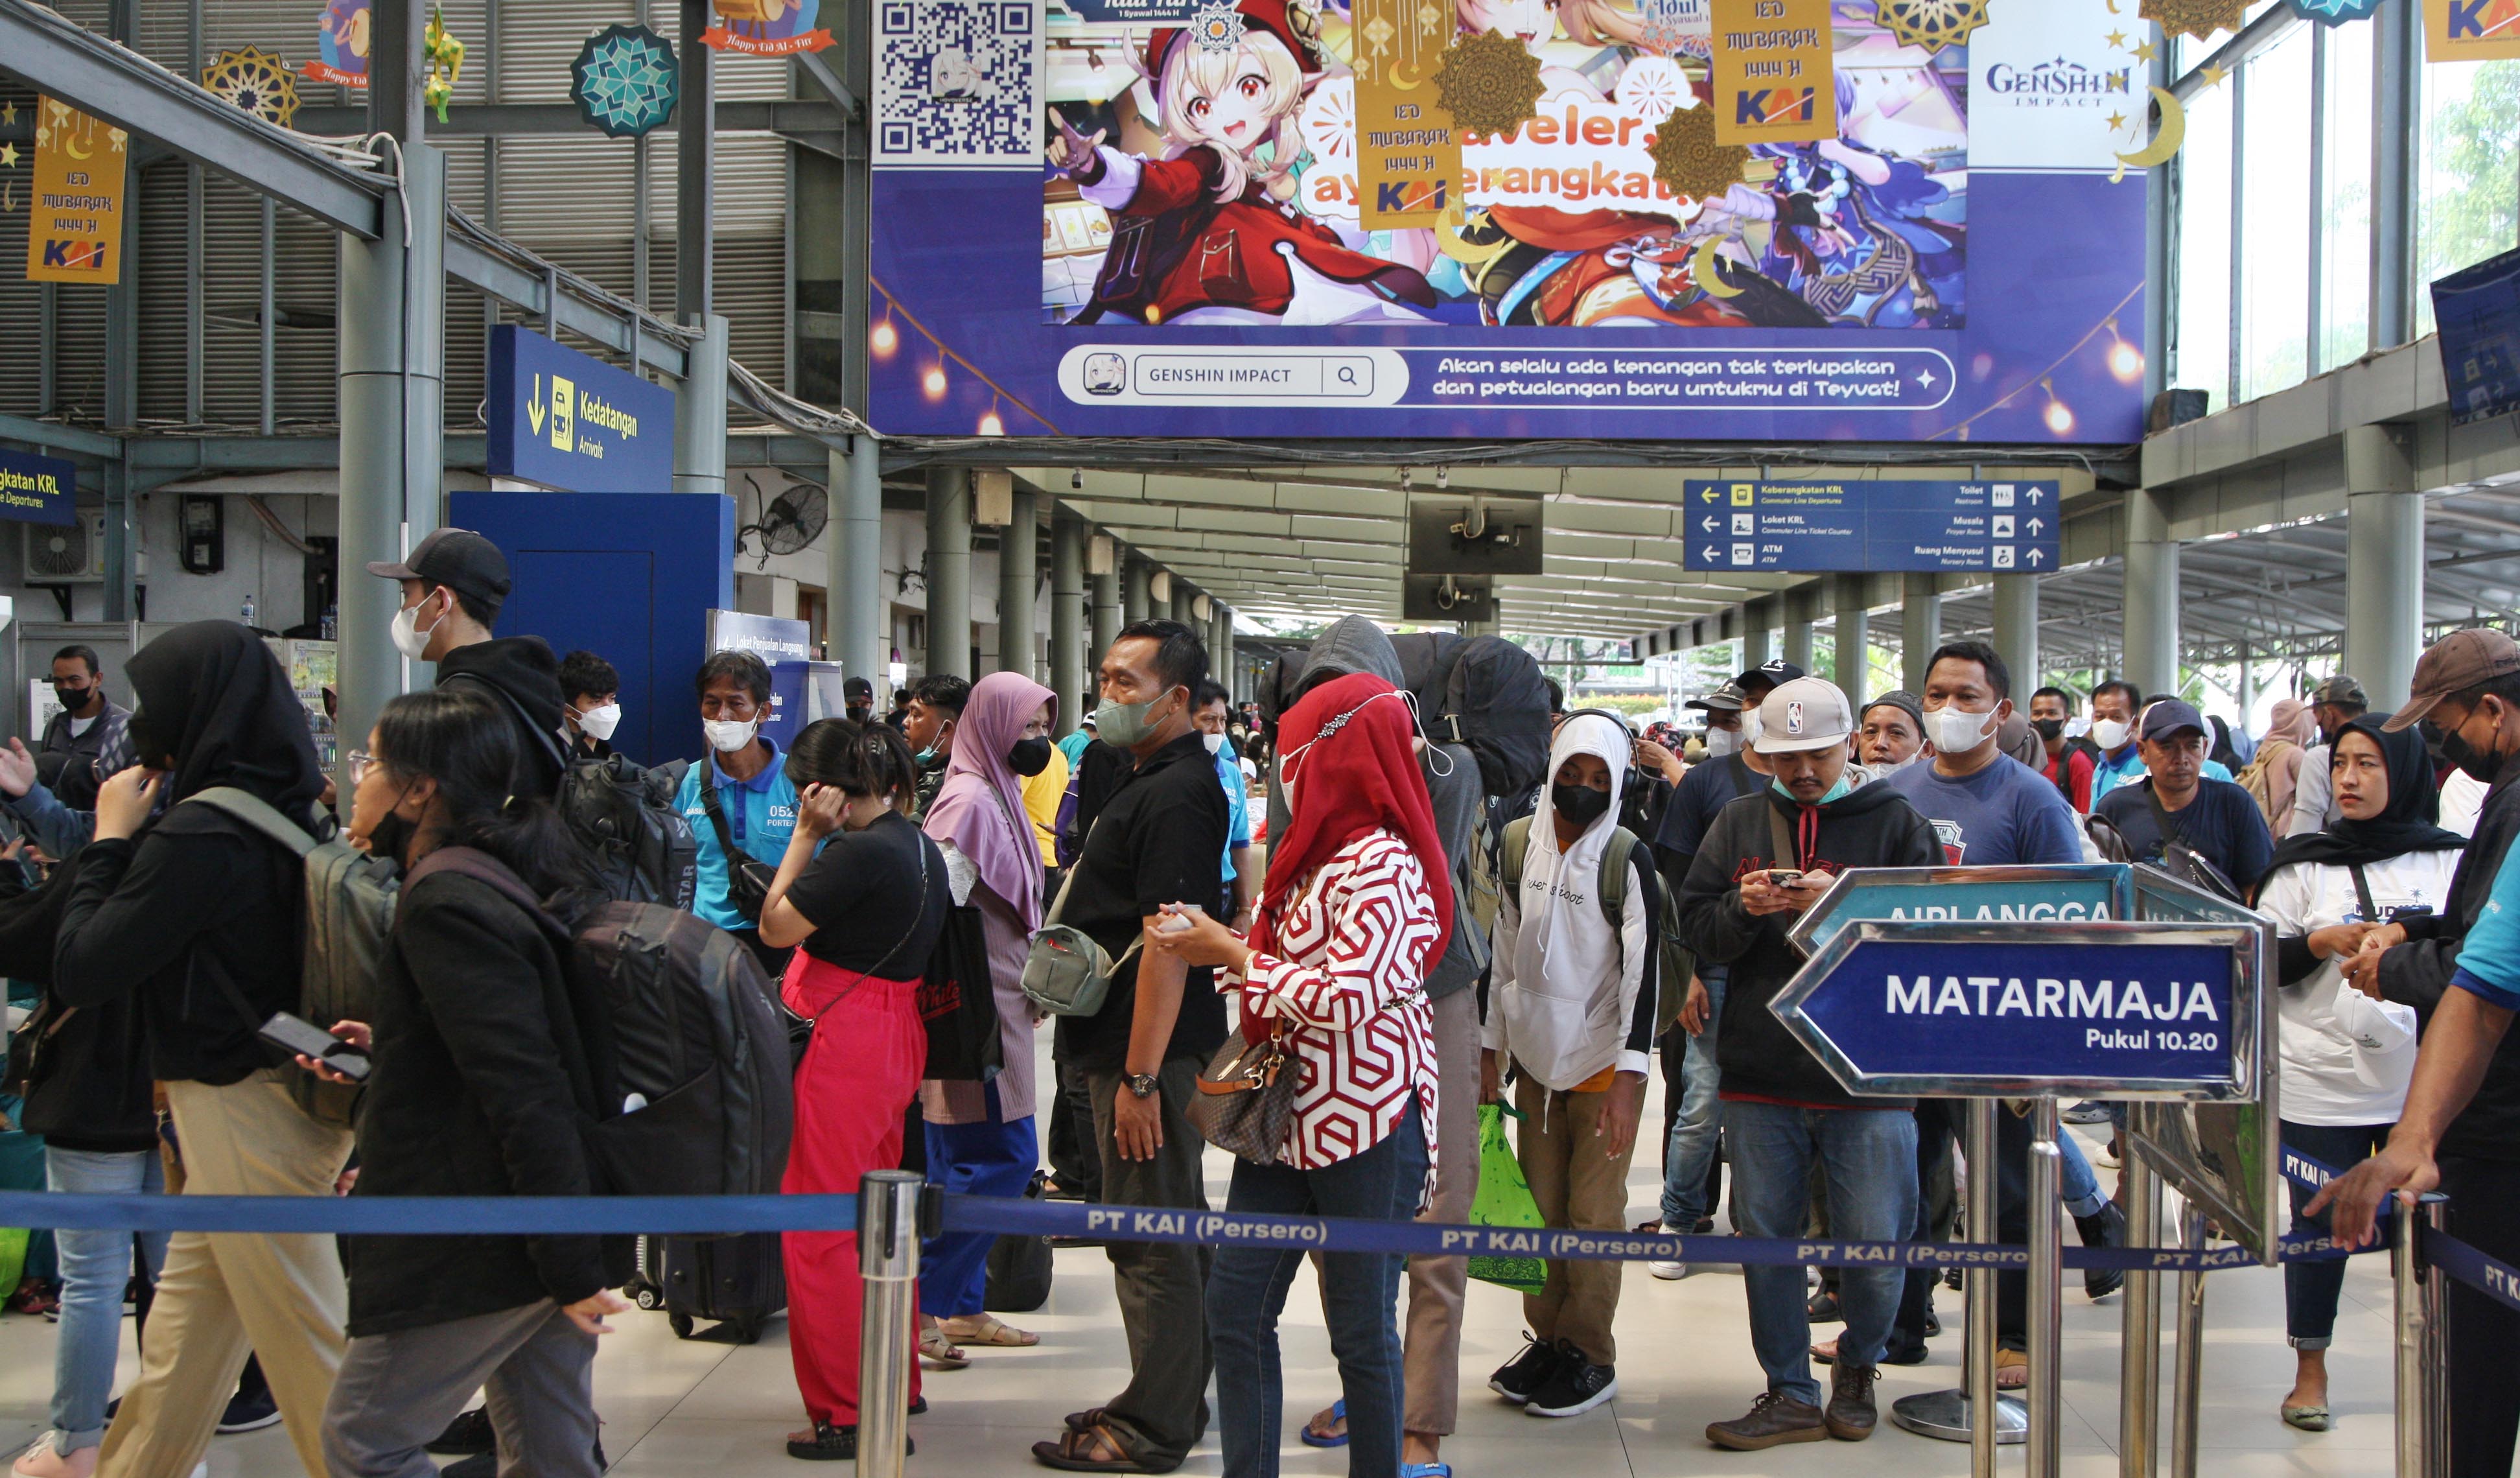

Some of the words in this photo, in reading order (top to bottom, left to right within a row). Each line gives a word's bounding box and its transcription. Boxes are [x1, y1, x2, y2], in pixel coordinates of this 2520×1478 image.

[1125, 9, 1152, 19] Syawal
[1755, 1, 1786, 19] IED
[725, 34, 756, 53] Happy
[1725, 27, 1821, 53] MUBARAK
[322, 67, 351, 85] Happy
[1745, 60, 1784, 80] 1444
[1736, 86, 1814, 124] KAI
[2014, 97, 2103, 107] IMPACT
[1394, 104, 1421, 121] IED
[1368, 129, 1452, 149] MUBARAK
[1385, 157, 1419, 173] 1444
[67, 172, 91, 187] IED
[42, 194, 114, 215] MUBARAK
[1377, 180, 1447, 213] KAI
[54, 218, 84, 233] 1444
[43, 239, 106, 268] KAI
[1150, 369, 1224, 382] GENSHIN
[1230, 370, 1291, 382] IMPACT
[1438, 358, 1494, 374] Akan
[1500, 358, 1560, 374] selalu
[1566, 359, 1608, 375] ada
[1614, 358, 1722, 376] kenangan
[1728, 360, 1766, 375] tak
[1771, 360, 1895, 377] terlupakan
[1432, 380, 1475, 395] dan
[1480, 380, 1621, 397] petualangan
[1626, 381, 1679, 396] baru
[1685, 381, 1783, 396] untukmu
[1788, 381, 1808, 396] di
[1814, 380, 1900, 398] Teyvat!
[580, 390, 638, 441] Kedatangan
[578, 435, 603, 460] Arrivals
[38, 473, 60, 495] KRL
[1761, 486, 1825, 495] Keberangkatan
[1826, 486, 1843, 494] KRL
[1959, 486, 1983, 495] Toilet
[6, 491, 43, 508] Departures
[1762, 515, 1786, 524] Loket
[1788, 516, 1805, 524] KRL
[1953, 516, 1984, 525] Musala
[1762, 545, 1783, 553] ATM
[1914, 546, 1941, 556] Ruang
[1942, 546, 1984, 556] Menyusui
[1940, 557, 1965, 566] Nursery
[736, 634, 752, 649] Loket
[752, 636, 778, 654] Penjualan
[779, 639, 804, 657] Langsung
[767, 819, 795, 827] PORTER
[1887, 975, 2219, 1021] MATARMAJA
[2086, 1028, 2150, 1050] Pukul
[2156, 1031, 2219, 1051] 10.20
[2286, 1154, 2300, 1176] PT
[2301, 1162, 2318, 1186] KAI
[1088, 1210, 1125, 1231] PT
[1134, 1212, 1185, 1234] KAI
[1196, 1215, 1327, 1245] (Persero)
[1441, 1231, 1479, 1249] PT
[1489, 1232, 1540, 1252] KAI
[1550, 1234, 1683, 1258] (Persero)
[1797, 1245, 1835, 1260] PT
[1844, 1245, 1896, 1261] KAI
[1906, 1246, 2029, 1264] (Persero
[2153, 1254, 2191, 1266] PT
[2199, 1247, 2250, 1266] KAI
[2484, 1263, 2504, 1293] PT
